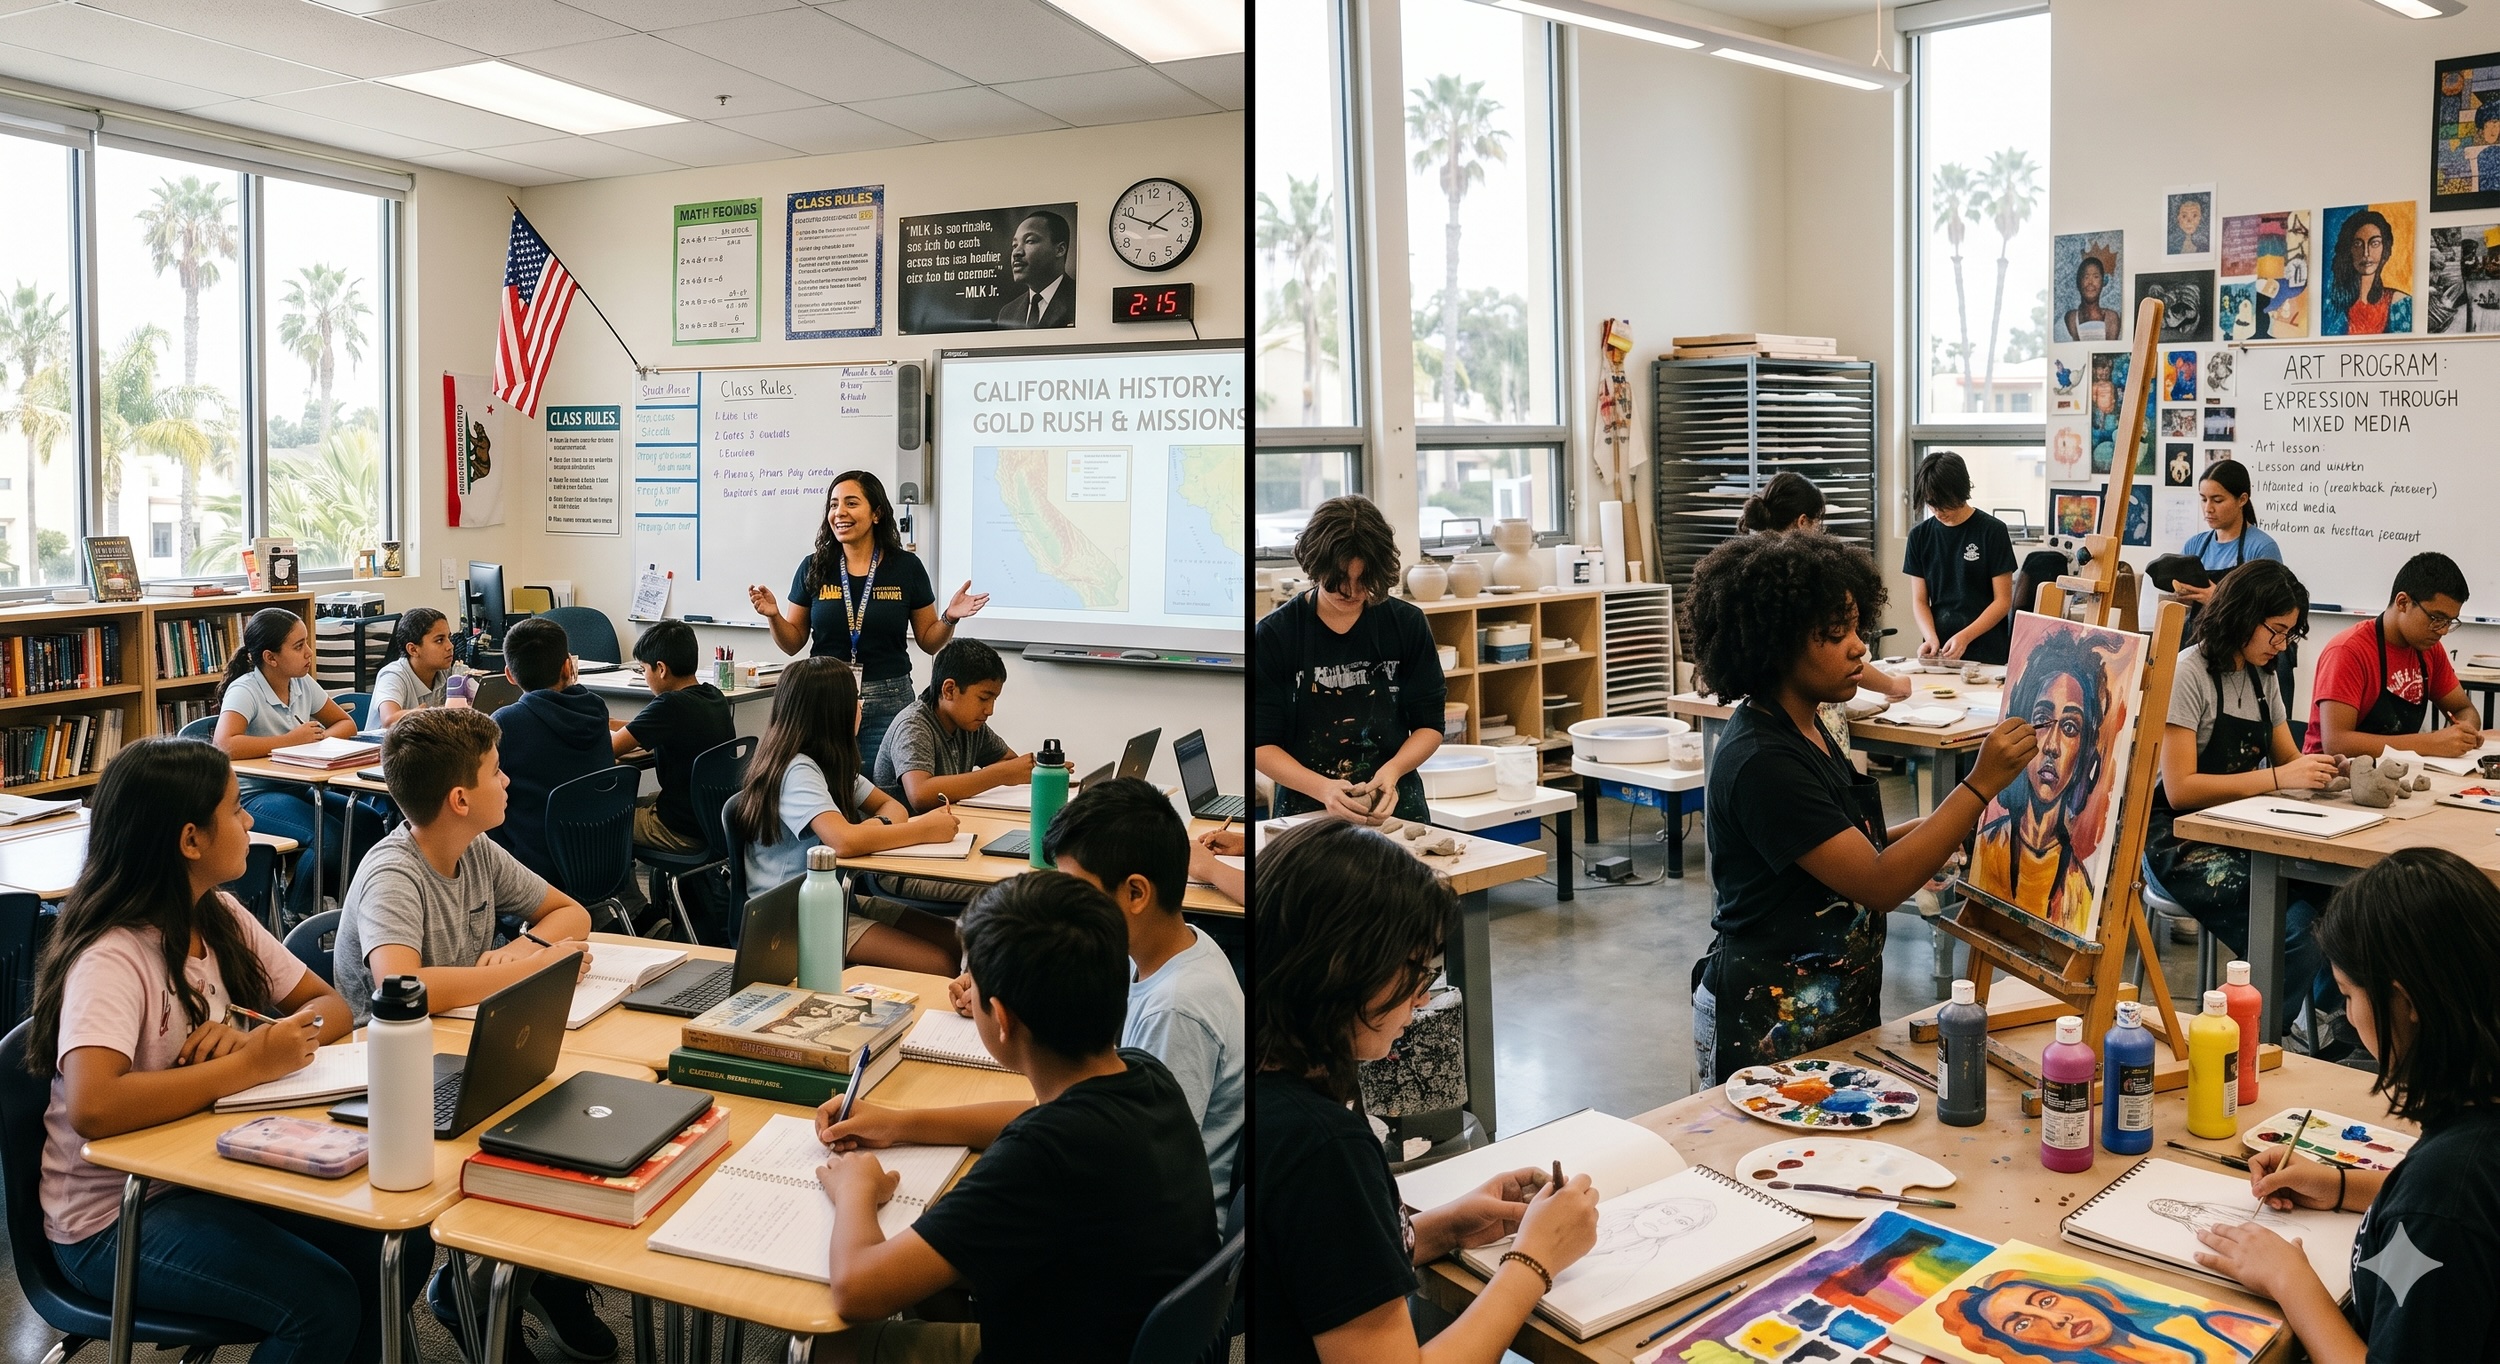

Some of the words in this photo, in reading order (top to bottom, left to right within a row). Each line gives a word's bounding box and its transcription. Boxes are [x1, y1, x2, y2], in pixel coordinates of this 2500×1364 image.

[1147, 188, 1160, 199] 12
[1167, 191, 1172, 201] 1
[795, 196, 833, 210] CLASS
[834, 192, 873, 206] RULES
[1134, 194, 1144, 205] 11
[1122, 207, 1135, 217] 10
[1177, 202, 1184, 213] 2
[680, 208, 709, 221] MATH
[1119, 223, 1126, 233] 9
[1181, 217, 1189, 228] 3
[1123, 238, 1130, 248] 8
[1176, 234, 1184, 244] 4
[1135, 249, 1142, 259] 7
[1150, 252, 1156, 262] 6
[1165, 246, 1172, 257] 5
[988, 285, 999, 297] Jr.
[1130, 291, 1176, 316] 2:15
[2284, 354, 2325, 380] ART
[2340, 352, 2448, 378] PROGRAM:
[721, 381, 754, 398] Class
[973, 378, 1111, 403] CALIFORNIA
[1119, 375, 1232, 400] HISTORY:
[2264, 391, 2369, 410] EXPRESSION
[2379, 389, 2459, 407] THROUGH
[550, 411, 582, 426] CLASS
[973, 412, 1034, 434] GOLD
[1043, 410, 1103, 433] RUSH
[1112, 409, 1128, 432] &
[1136, 407, 1245, 432] MISSIONS
[2293, 415, 2345, 432] MIXED
[2354, 415, 2411, 432] MEDIA
[2255, 440, 2275, 453] Art
[2258, 461, 2295, 472] Lesson
[2300, 461, 2321, 471] and
[2266, 501, 2298, 512] mixed
[2303, 501, 2336, 514] media
